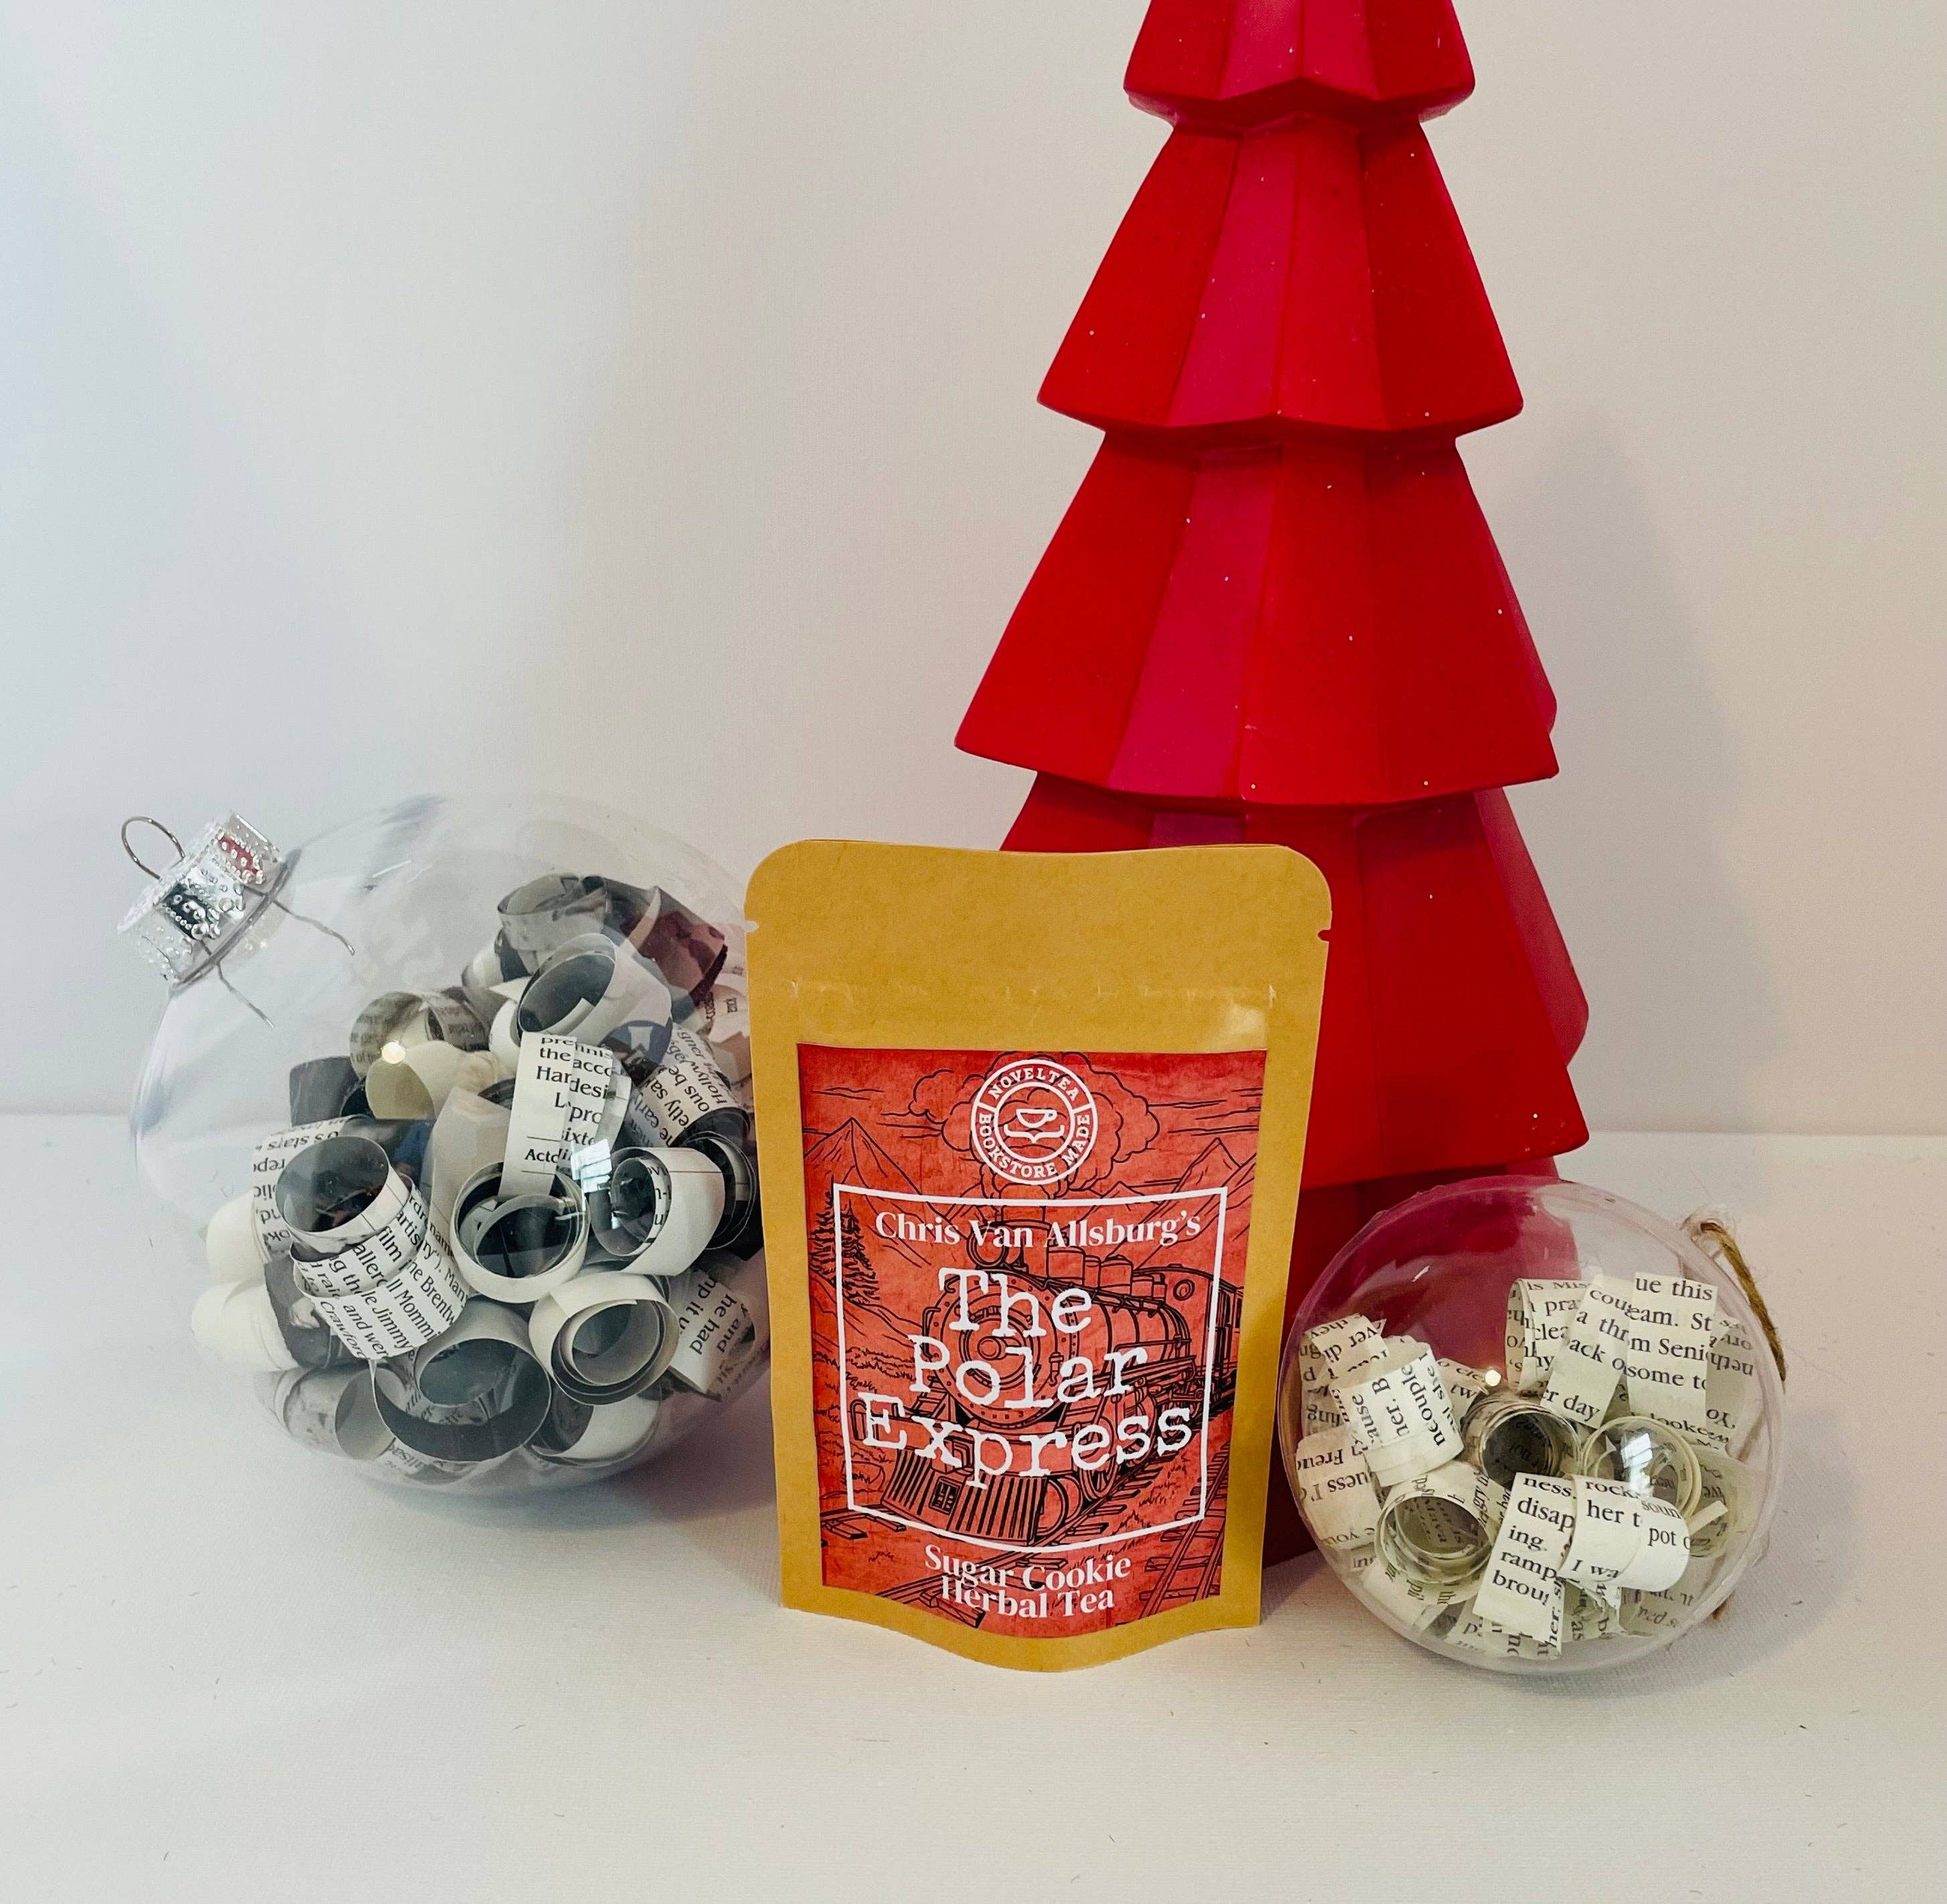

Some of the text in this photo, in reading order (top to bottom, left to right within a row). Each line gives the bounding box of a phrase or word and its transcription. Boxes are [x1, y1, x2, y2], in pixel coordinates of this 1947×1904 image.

[539, 1046, 571, 1062] the
[684, 1085, 711, 1113] ous
[988, 1066, 1080, 1102] NOVELTEA
[979, 1113, 1090, 1178] BOOKSTORE MADE
[876, 1210, 1201, 1248] Chris Van Allsburg's
[938, 1267, 1092, 1338] The
[1635, 1276, 1713, 1301] ue this
[343, 1303, 370, 1332] and
[1575, 1309, 1589, 1325] a
[689, 1318, 720, 1355] had
[716, 1318, 740, 1353] and
[1569, 1338, 1607, 1363] ack
[907, 1334, 1148, 1410] Polar
[1563, 1394, 1601, 1422] day
[859, 1393, 1193, 1489] Express
[1586, 1500, 1624, 1525] her
[1648, 1527, 1677, 1547] pot
[924, 1544, 1132, 1593] Sugar Cookie
[942, 1579, 1115, 1619] Herbal Tea
